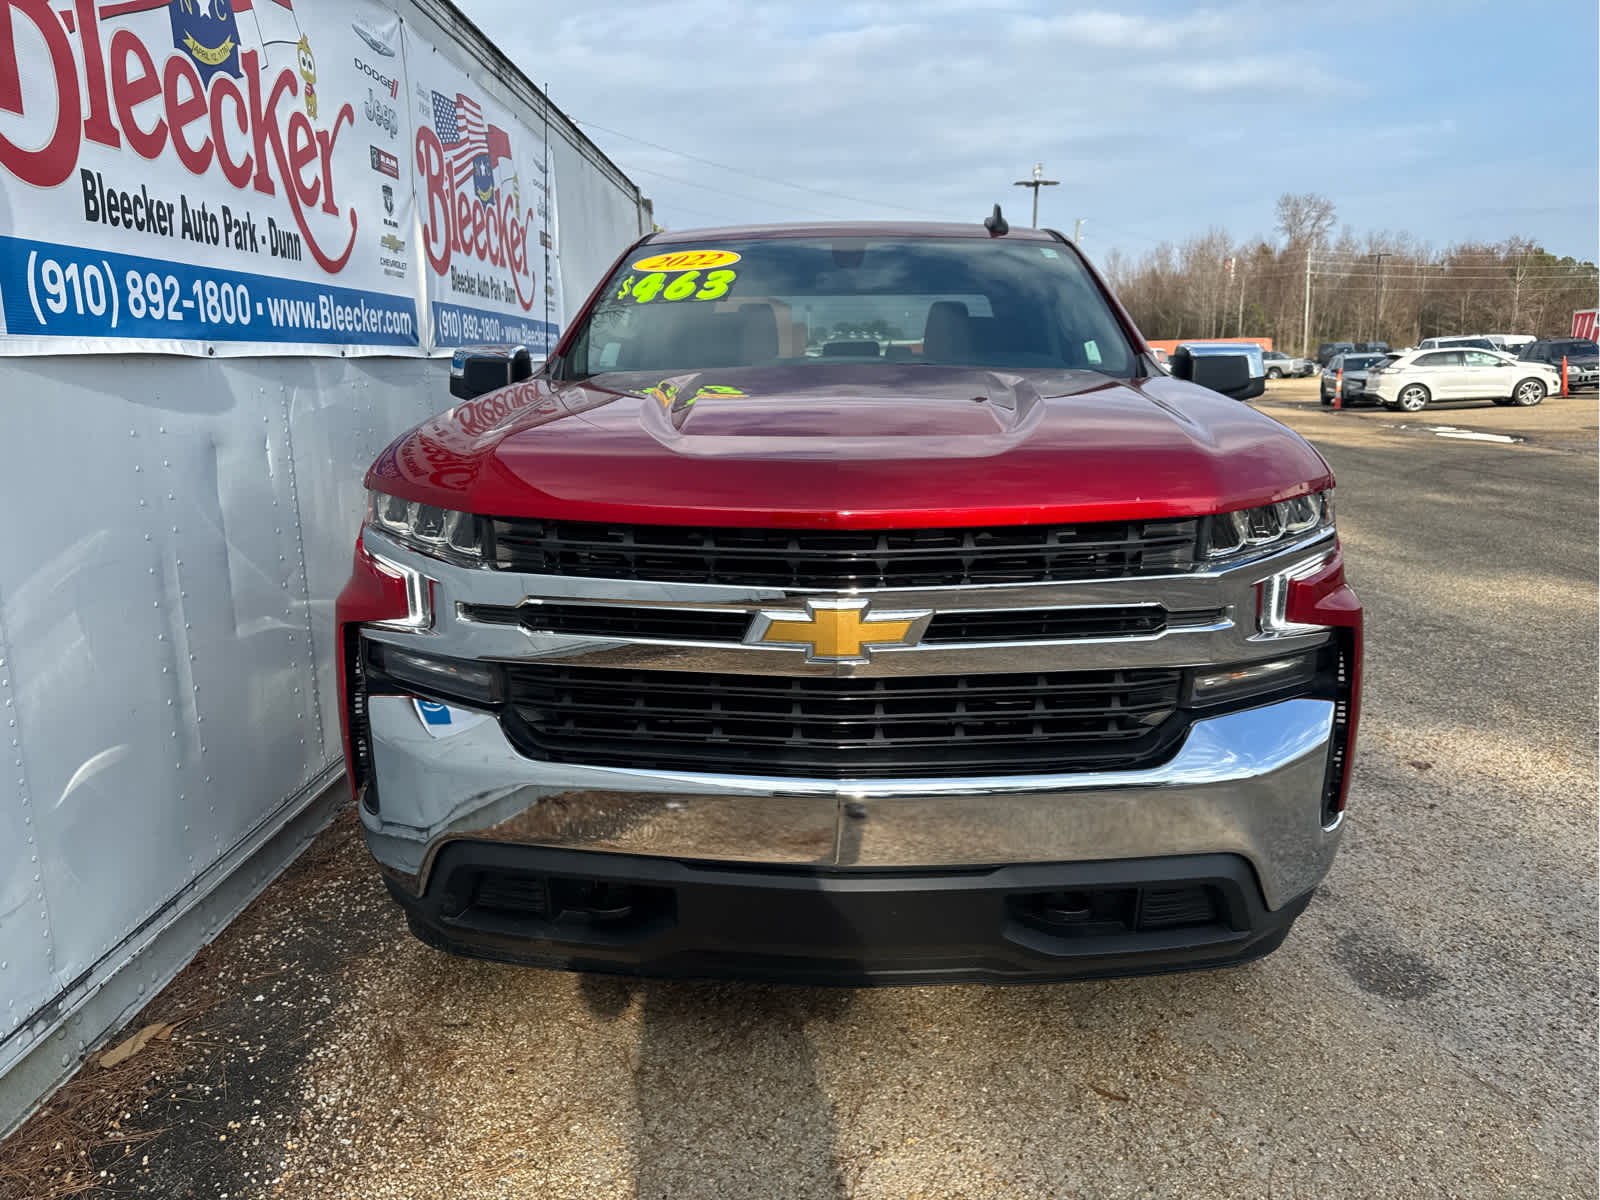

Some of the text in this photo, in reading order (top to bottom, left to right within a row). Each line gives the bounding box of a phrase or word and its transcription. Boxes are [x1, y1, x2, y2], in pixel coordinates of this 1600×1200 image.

[354, 57, 394, 90] DODGE
[364, 87, 399, 140] Jeep
[80, 168, 302, 261] Bleecker Auto Park Dunn
[416, 126, 536, 312] Bleecker
[380, 257, 407, 270] CHEVROLET
[648, 253, 724, 268] 2022
[27, 250, 412, 336] (910) 892-1800 www.Bleecker.com
[450, 265, 476, 296] Bleecker
[617, 270, 737, 304] $463
[438, 307, 461, 344] (910)
[462, 313, 500, 341] 892-1800
